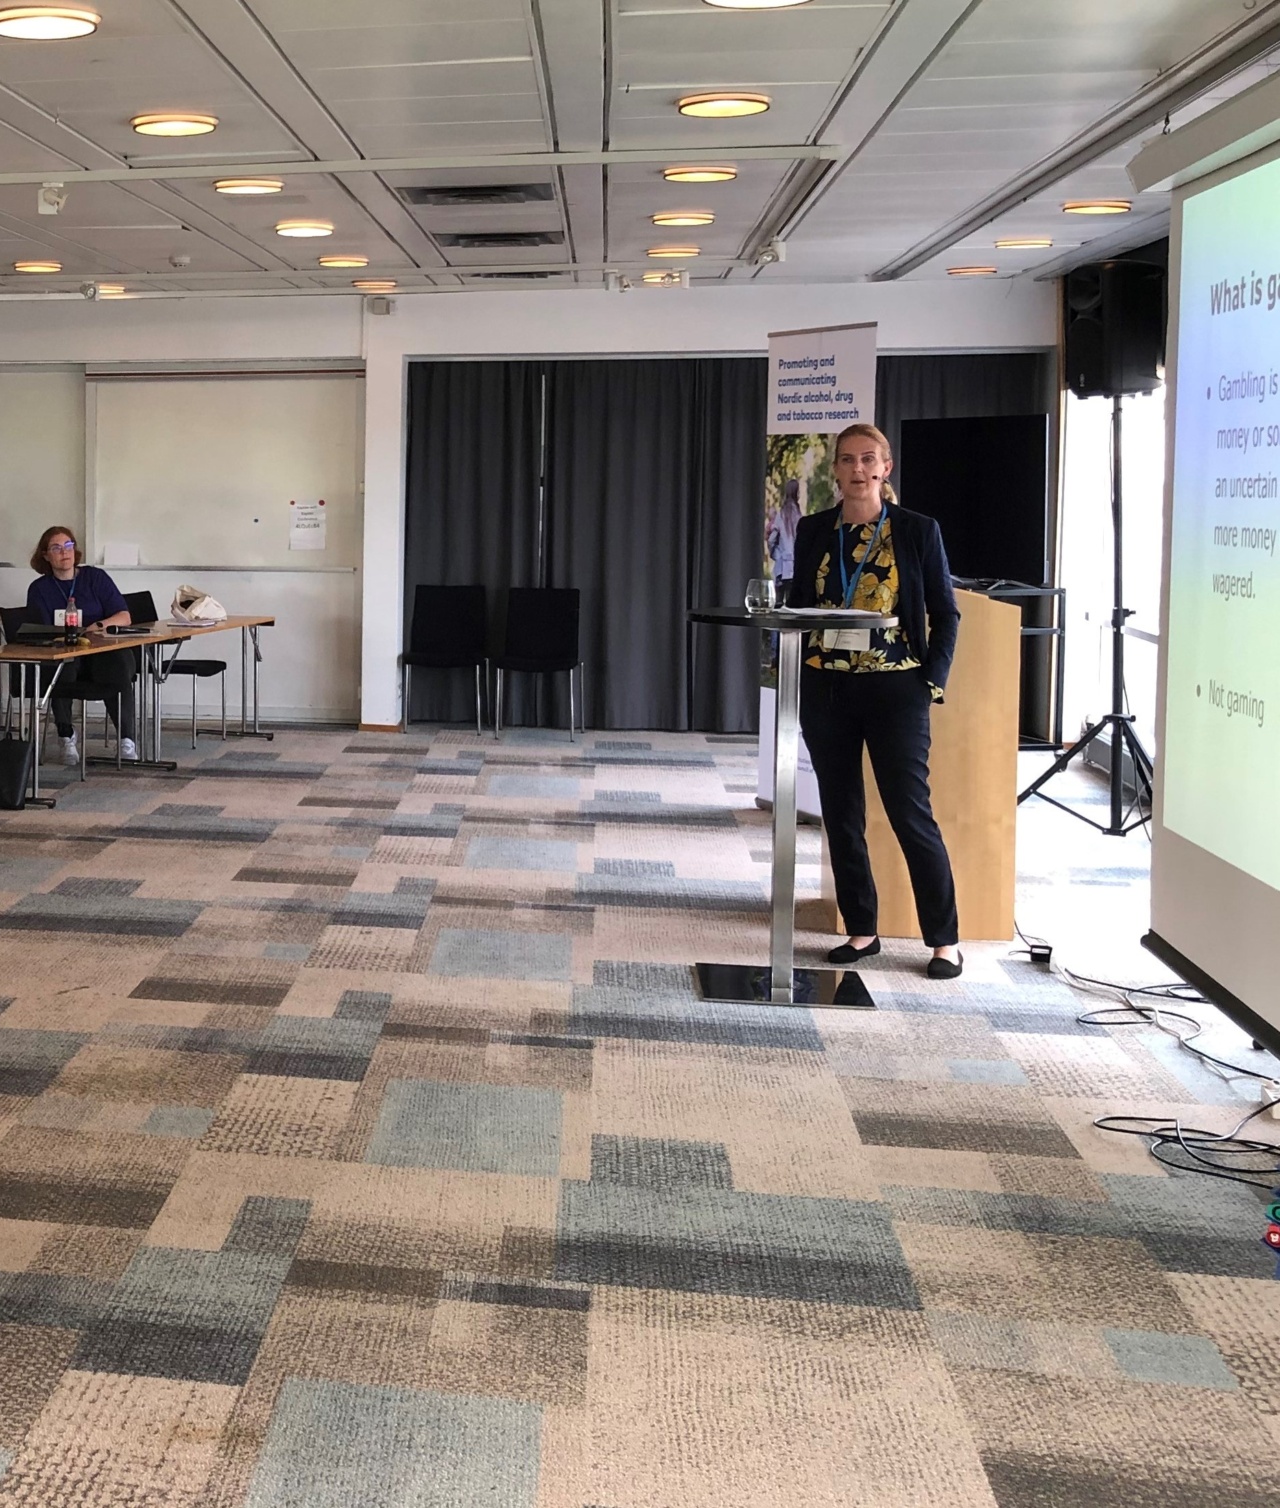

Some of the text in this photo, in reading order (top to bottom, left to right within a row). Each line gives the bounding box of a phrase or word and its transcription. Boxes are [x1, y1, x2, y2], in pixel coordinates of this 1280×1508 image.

[1210, 276, 1246, 316] What
[1250, 270, 1263, 306] is
[778, 355, 835, 370] Promoting and
[777, 373, 837, 387] communicating
[1218, 368, 1278, 403] Gambling is
[777, 390, 853, 404] Nordic alcohol, drug
[777, 407, 859, 421] and tobacco research
[1216, 427, 1250, 454] money
[1252, 425, 1264, 448] or
[1215, 471, 1278, 499] an uncertain
[1213, 525, 1277, 557] more money
[1212, 571, 1255, 601] wagered.
[1208, 678, 1265, 728] Not gaming
